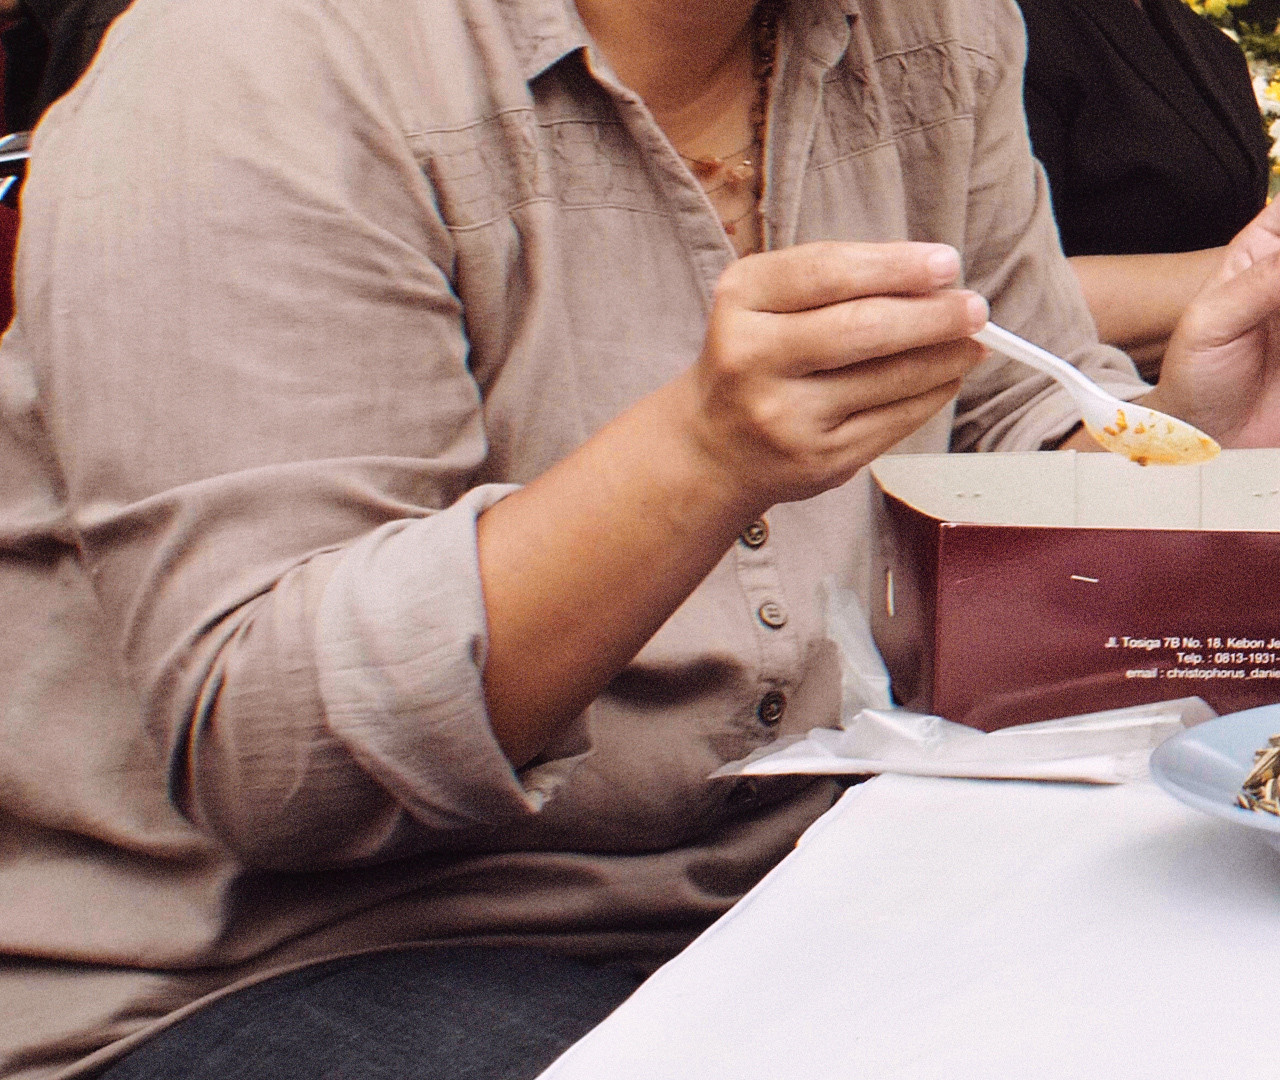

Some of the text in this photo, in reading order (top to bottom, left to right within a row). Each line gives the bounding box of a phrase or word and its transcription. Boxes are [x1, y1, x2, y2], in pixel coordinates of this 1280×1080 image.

[1121, 636, 1161, 651] Tosiga
[1163, 637, 1181, 649] 7B
[1227, 637, 1265, 649] Kebon
[1125, 668, 1158, 678] email
